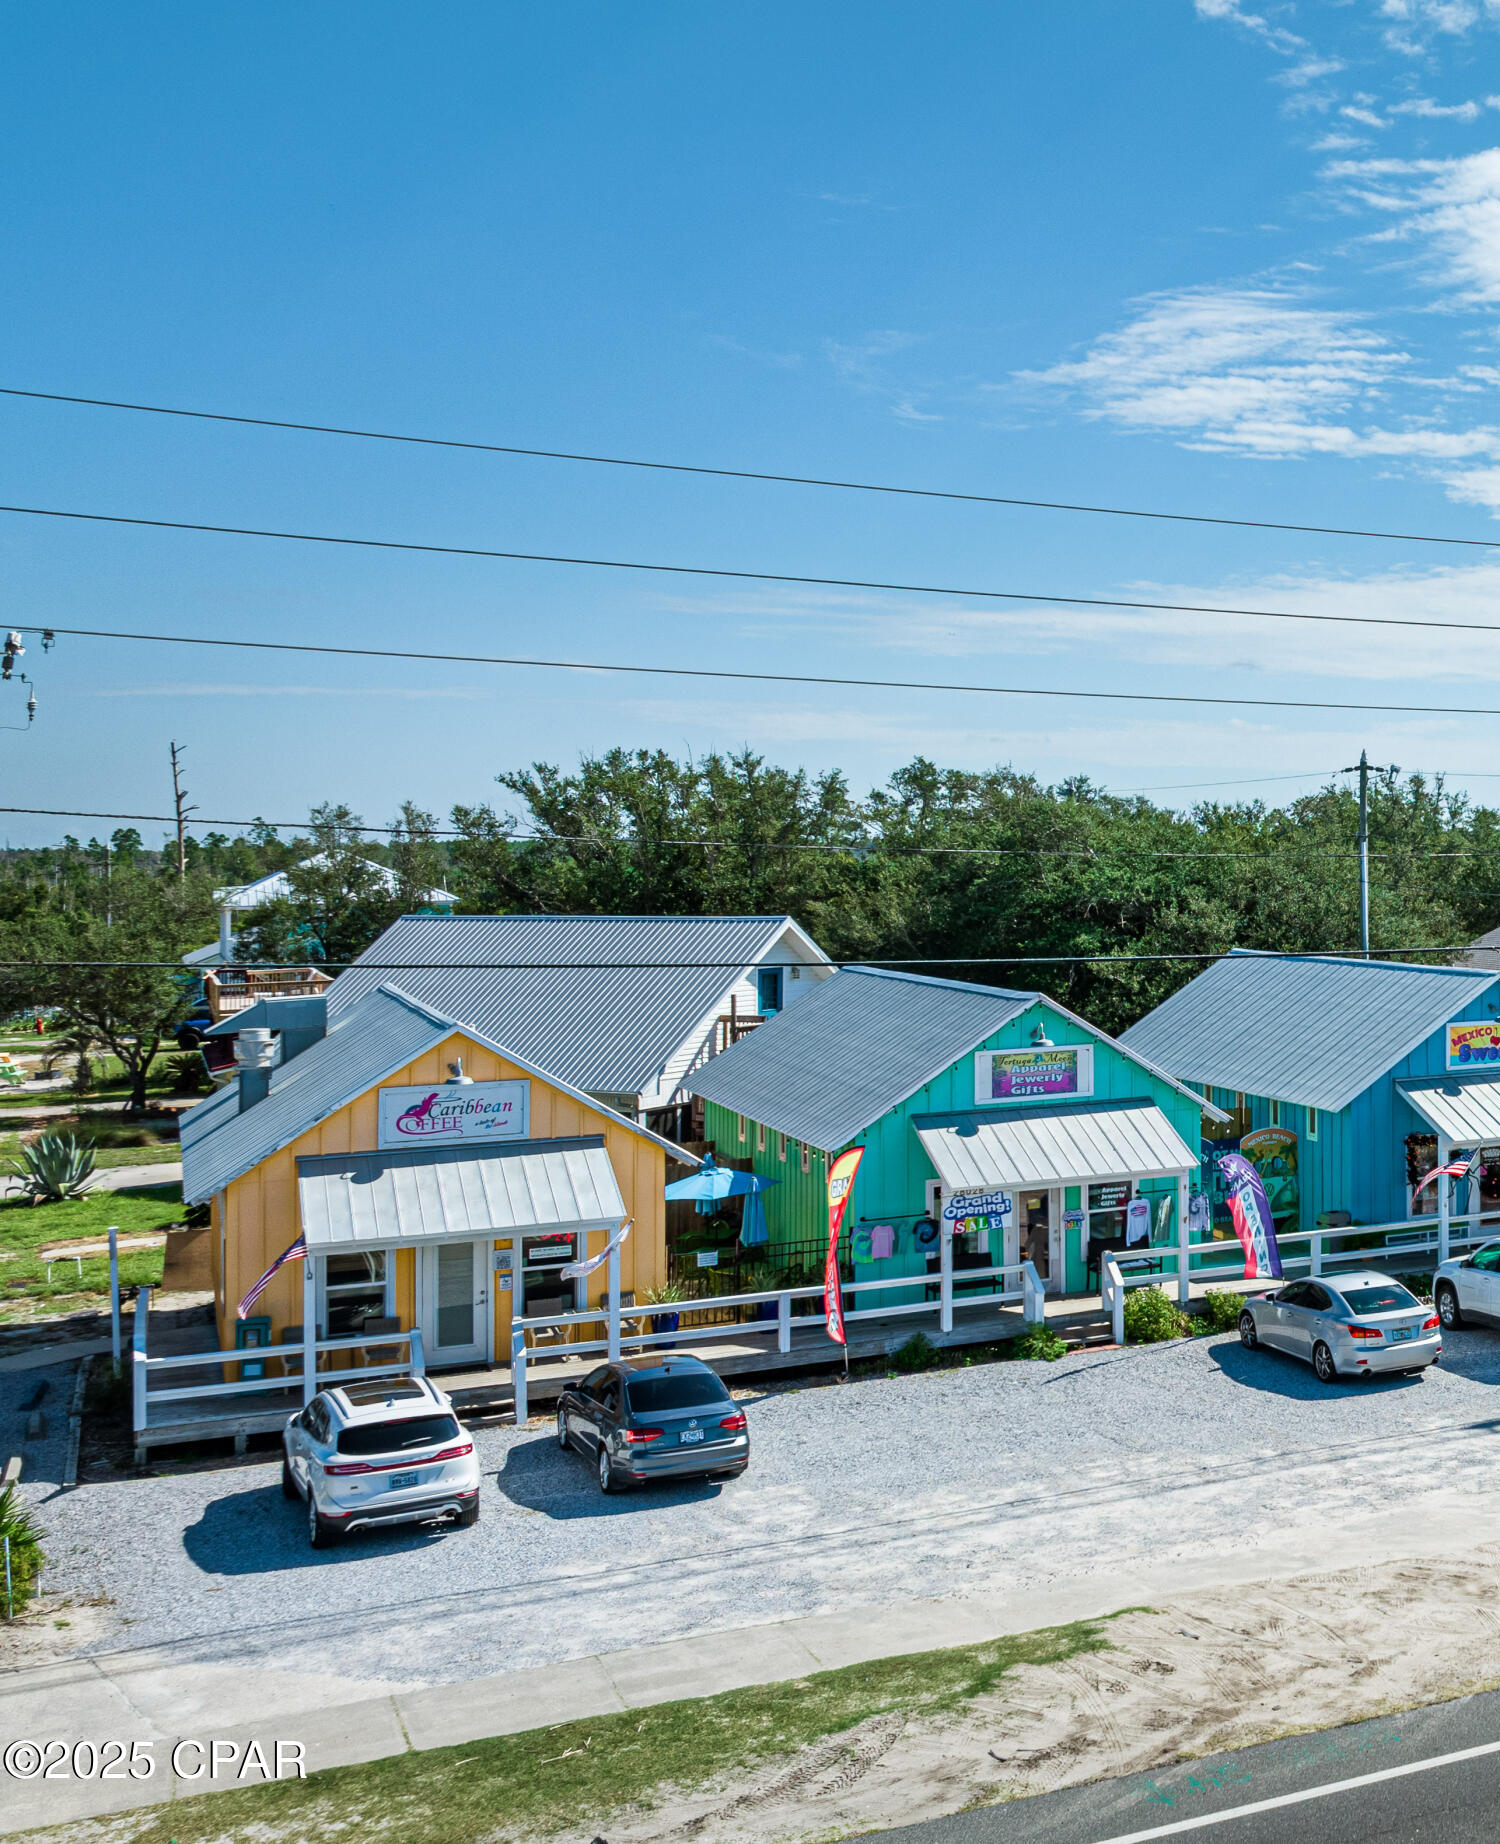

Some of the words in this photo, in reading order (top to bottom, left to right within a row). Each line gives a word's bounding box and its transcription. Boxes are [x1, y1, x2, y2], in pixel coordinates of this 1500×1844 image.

[1451, 1027, 1493, 1047] MEXICO
[1000, 1056, 1032, 1066] Tortuga
[1011, 1061, 1066, 1074] Apparel
[1011, 1073, 1064, 1085] Jewerly
[1011, 1085, 1045, 1096] Gifts
[428, 1098, 513, 1119] Caribbean
[952, 1191, 1002, 1208] Grand
[944, 1199, 1010, 1218] Opening!
[955, 1216, 1002, 1233] SALE
